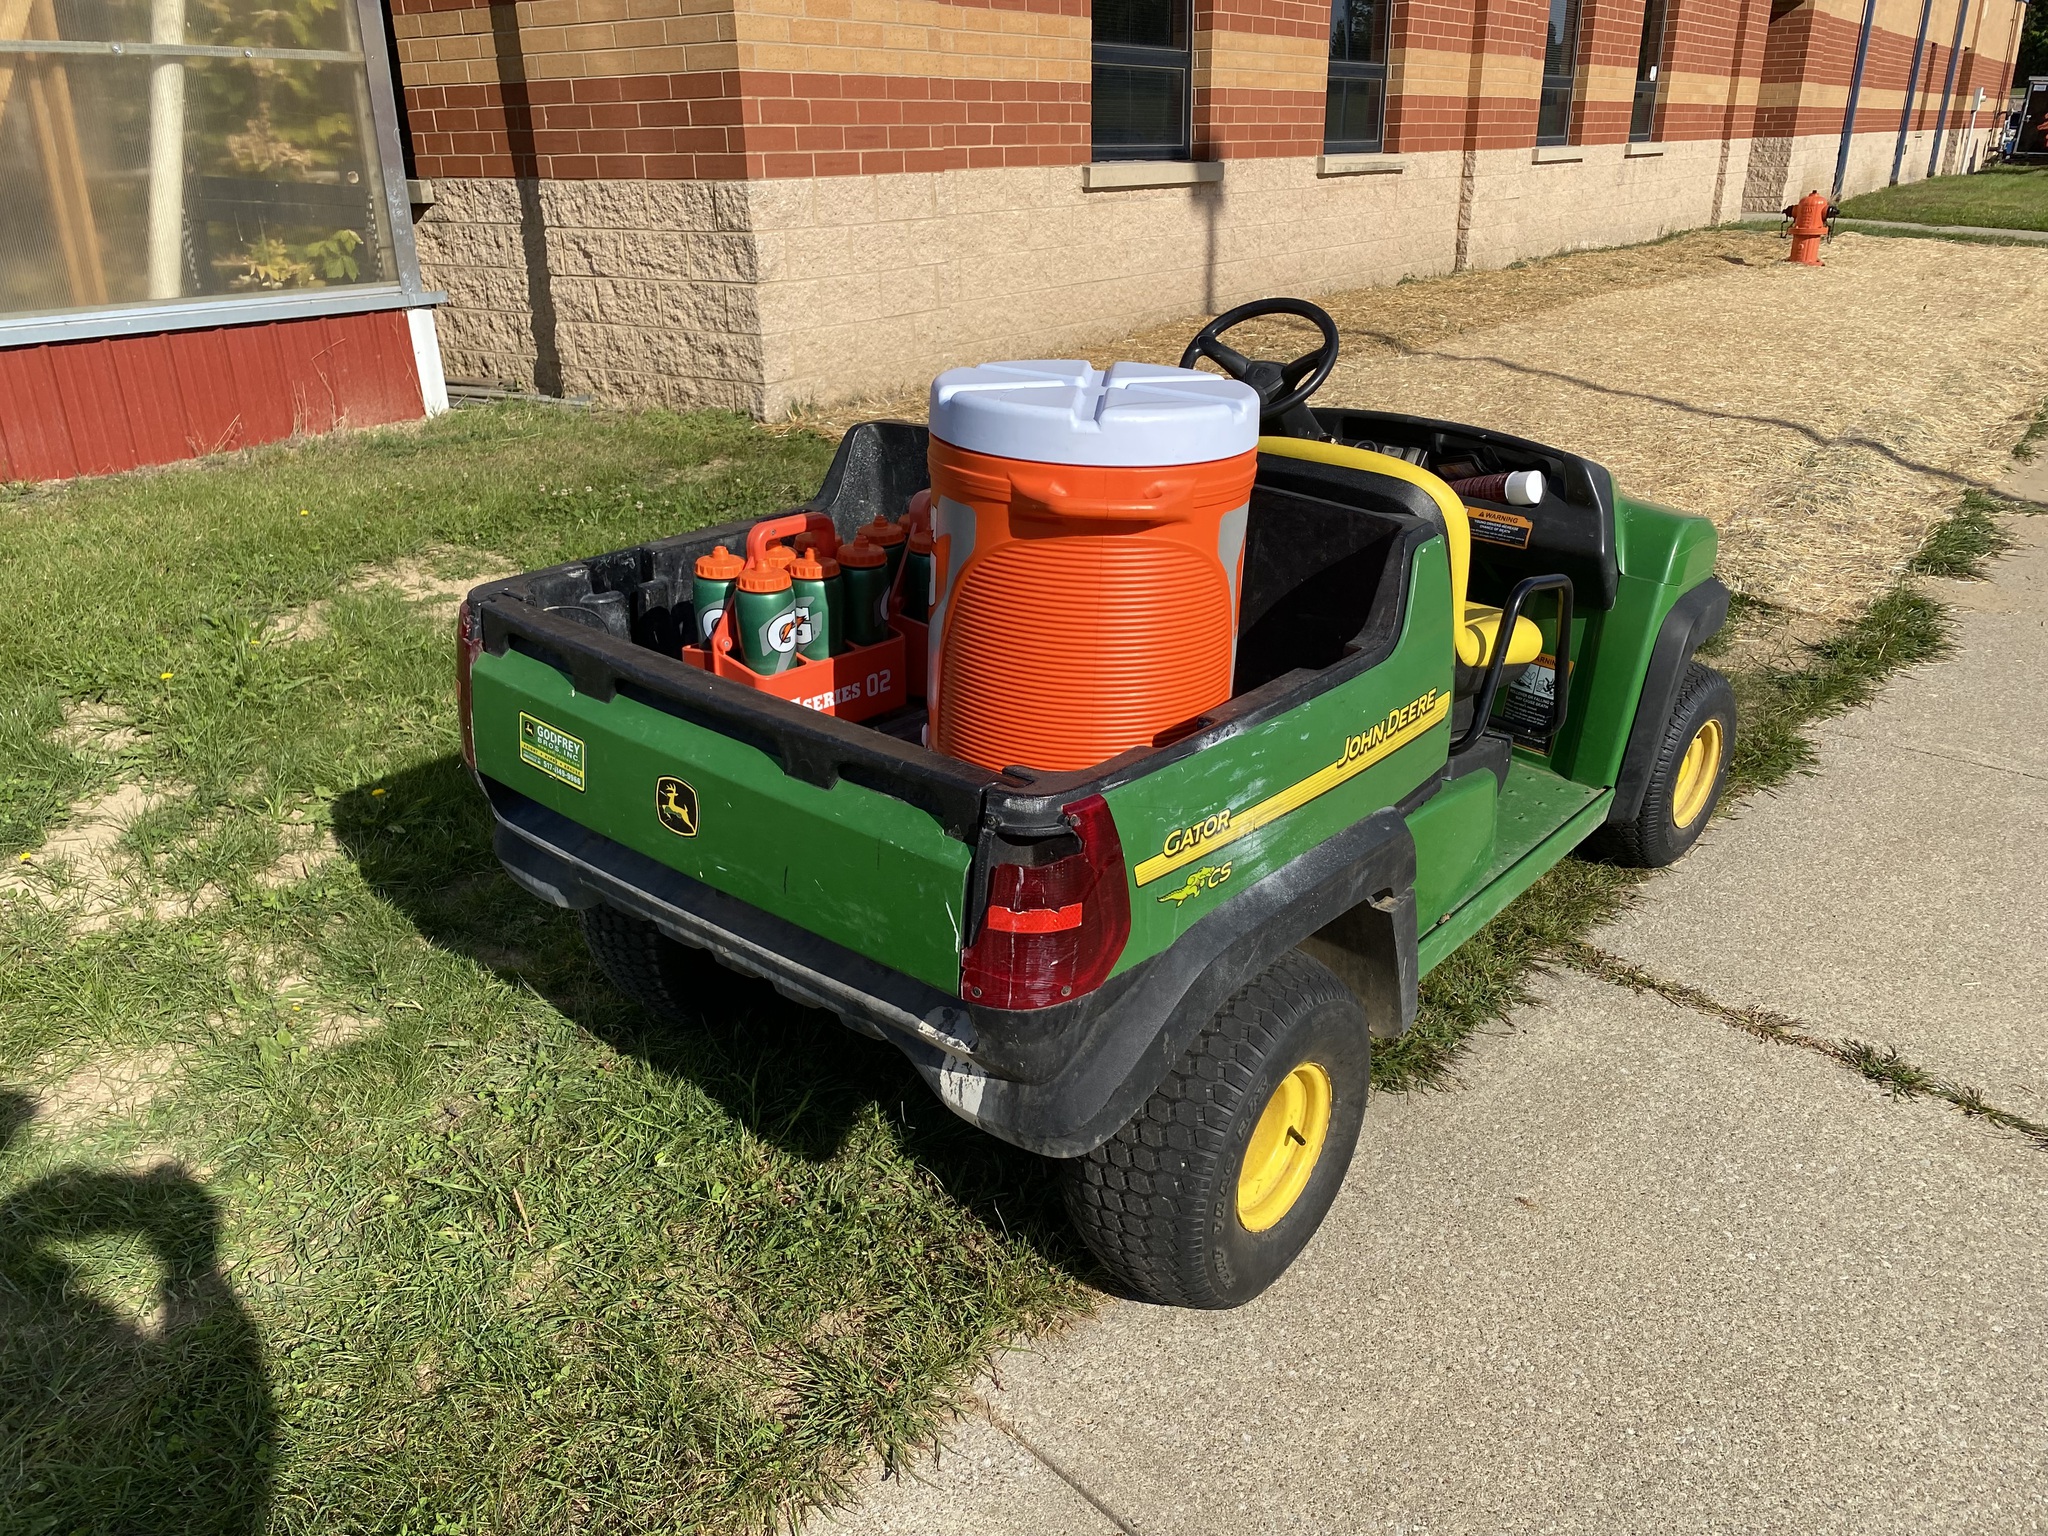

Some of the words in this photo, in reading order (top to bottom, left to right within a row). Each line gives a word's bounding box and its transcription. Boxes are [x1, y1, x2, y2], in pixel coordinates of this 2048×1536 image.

[1486, 512, 1518, 524] WARNING
[803, 682, 861, 711] SERIES
[866, 669, 891, 697] 02
[537, 726, 580, 755] GODFREY
[1337, 719, 1385, 769] JOHN
[1386, 686, 1437, 738] DEERE
[537, 737, 561, 753] BROS.
[563, 749, 580, 763] INC.
[1164, 808, 1231, 858] GATOR
[1208, 861, 1232, 889] CS
